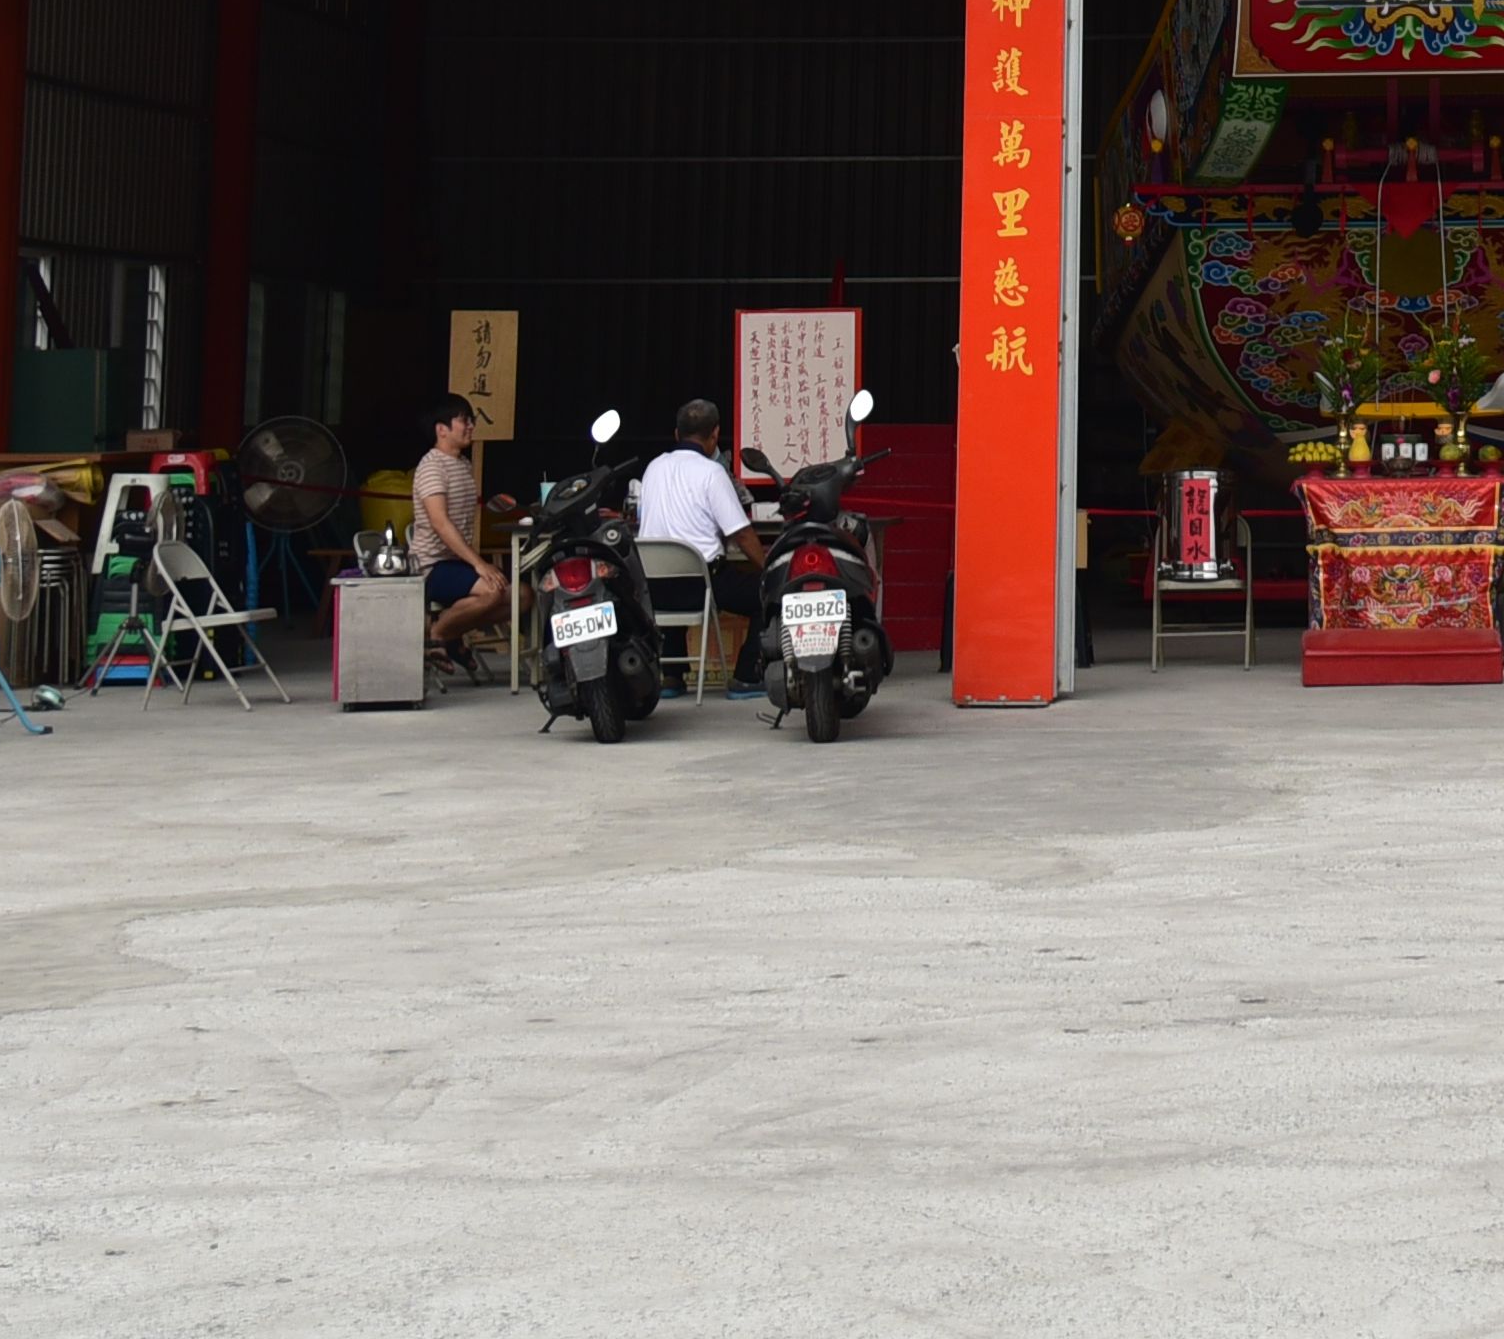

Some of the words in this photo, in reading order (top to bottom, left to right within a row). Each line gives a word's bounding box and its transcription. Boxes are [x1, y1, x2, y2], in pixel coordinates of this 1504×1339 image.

[468, 319, 495, 426] 請勿進入
[1185, 486, 1209, 561] 龍目水
[556, 611, 613, 642] 895-DWV
[785, 600, 846, 620] 509-BZG
